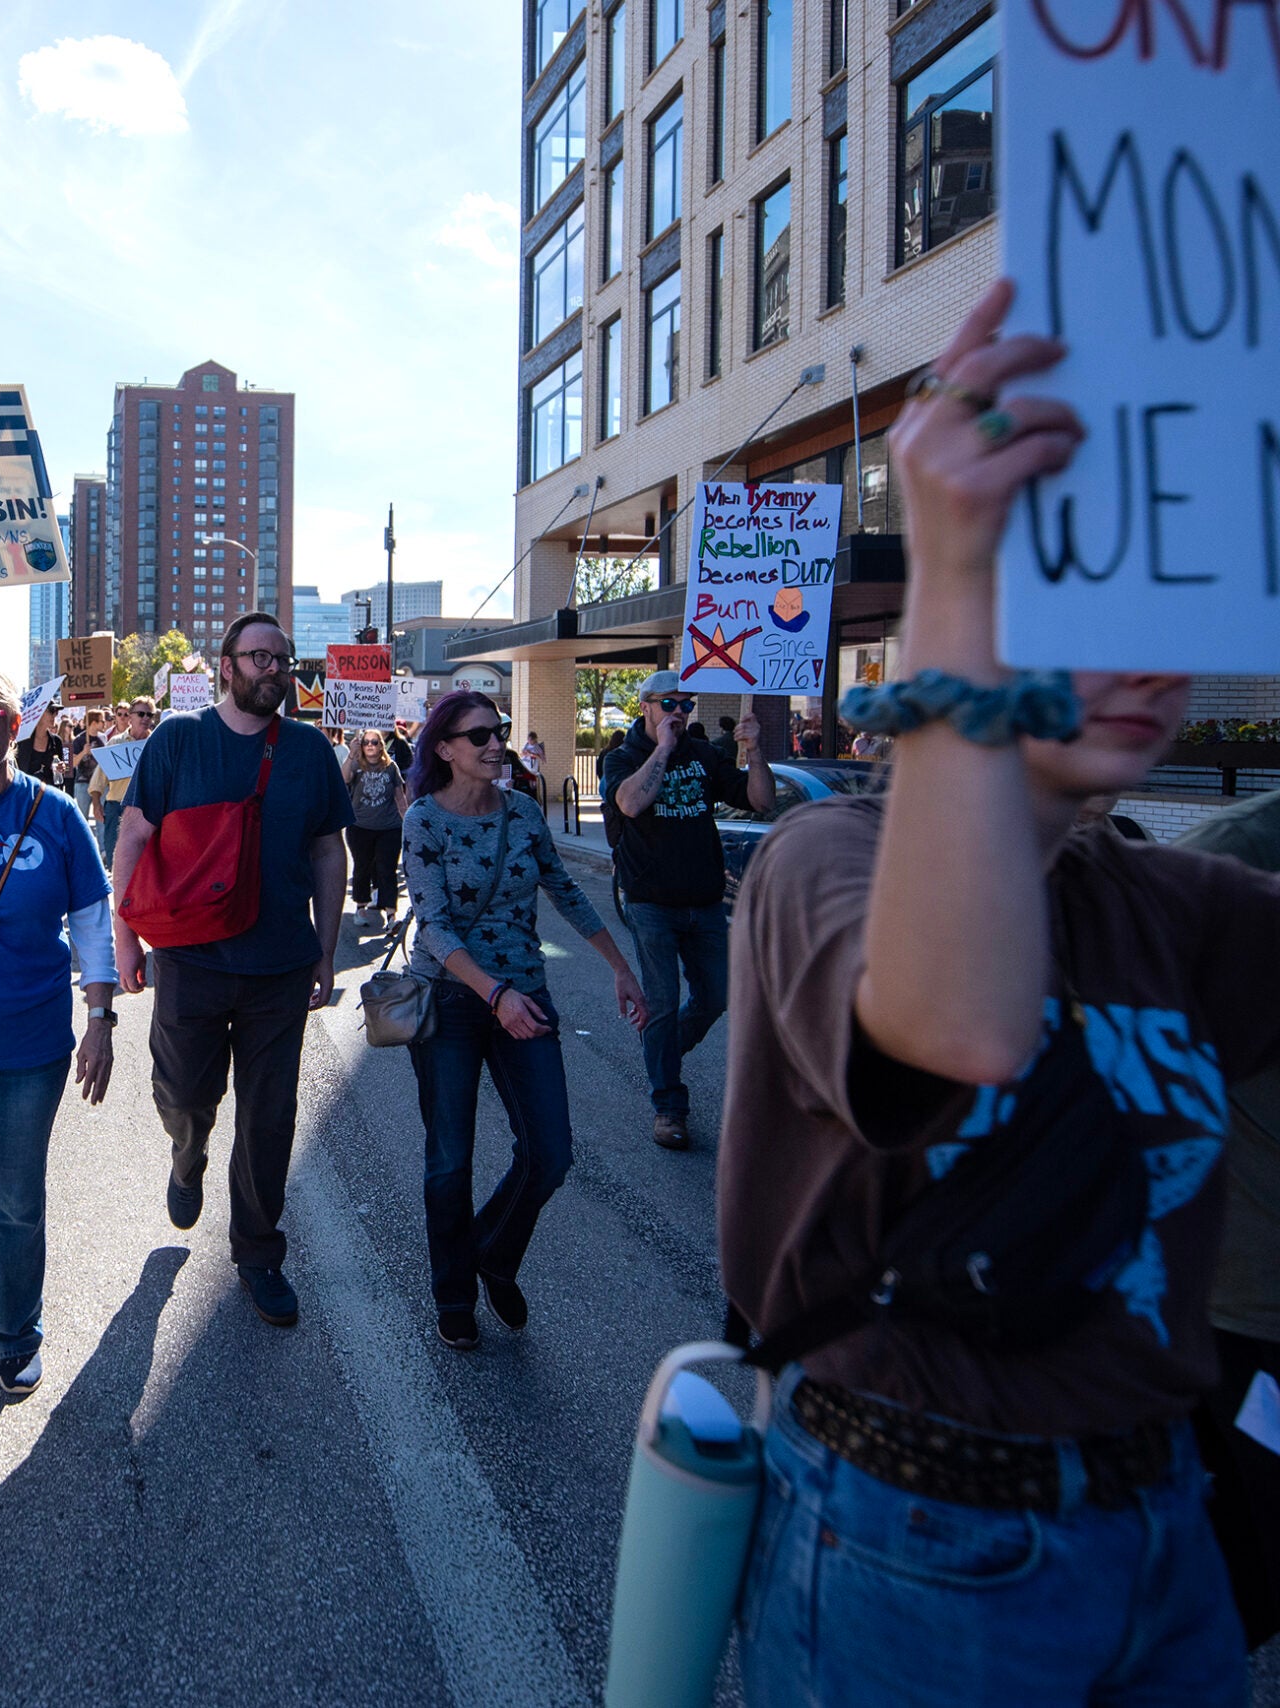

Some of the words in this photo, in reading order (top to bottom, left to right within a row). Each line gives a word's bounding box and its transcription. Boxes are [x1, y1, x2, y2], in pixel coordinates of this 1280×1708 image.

[704, 484, 740, 506] When
[744, 483, 816, 515] Tyranny
[1025, 404, 1221, 584] WE
[704, 507, 783, 530] becomes
[790, 512, 831, 532] law,
[698, 528, 801, 559] Rebellion
[698, 560, 779, 584] becomes
[781, 558, 836, 586] DUTY
[693, 593, 760, 622] Burn
[71, 640, 91, 656] WE
[758, 633, 818, 657] Since
[64, 656, 93, 671] THE
[338, 655, 390, 671] PRISON
[62, 672, 107, 688] PEOPLE
[176, 675, 201, 684] MAKE
[172, 685, 206, 694] AMERICA
[325, 690, 347, 708] NO
[354, 692, 380, 702] KINGS
[325, 708, 347, 725] NO
